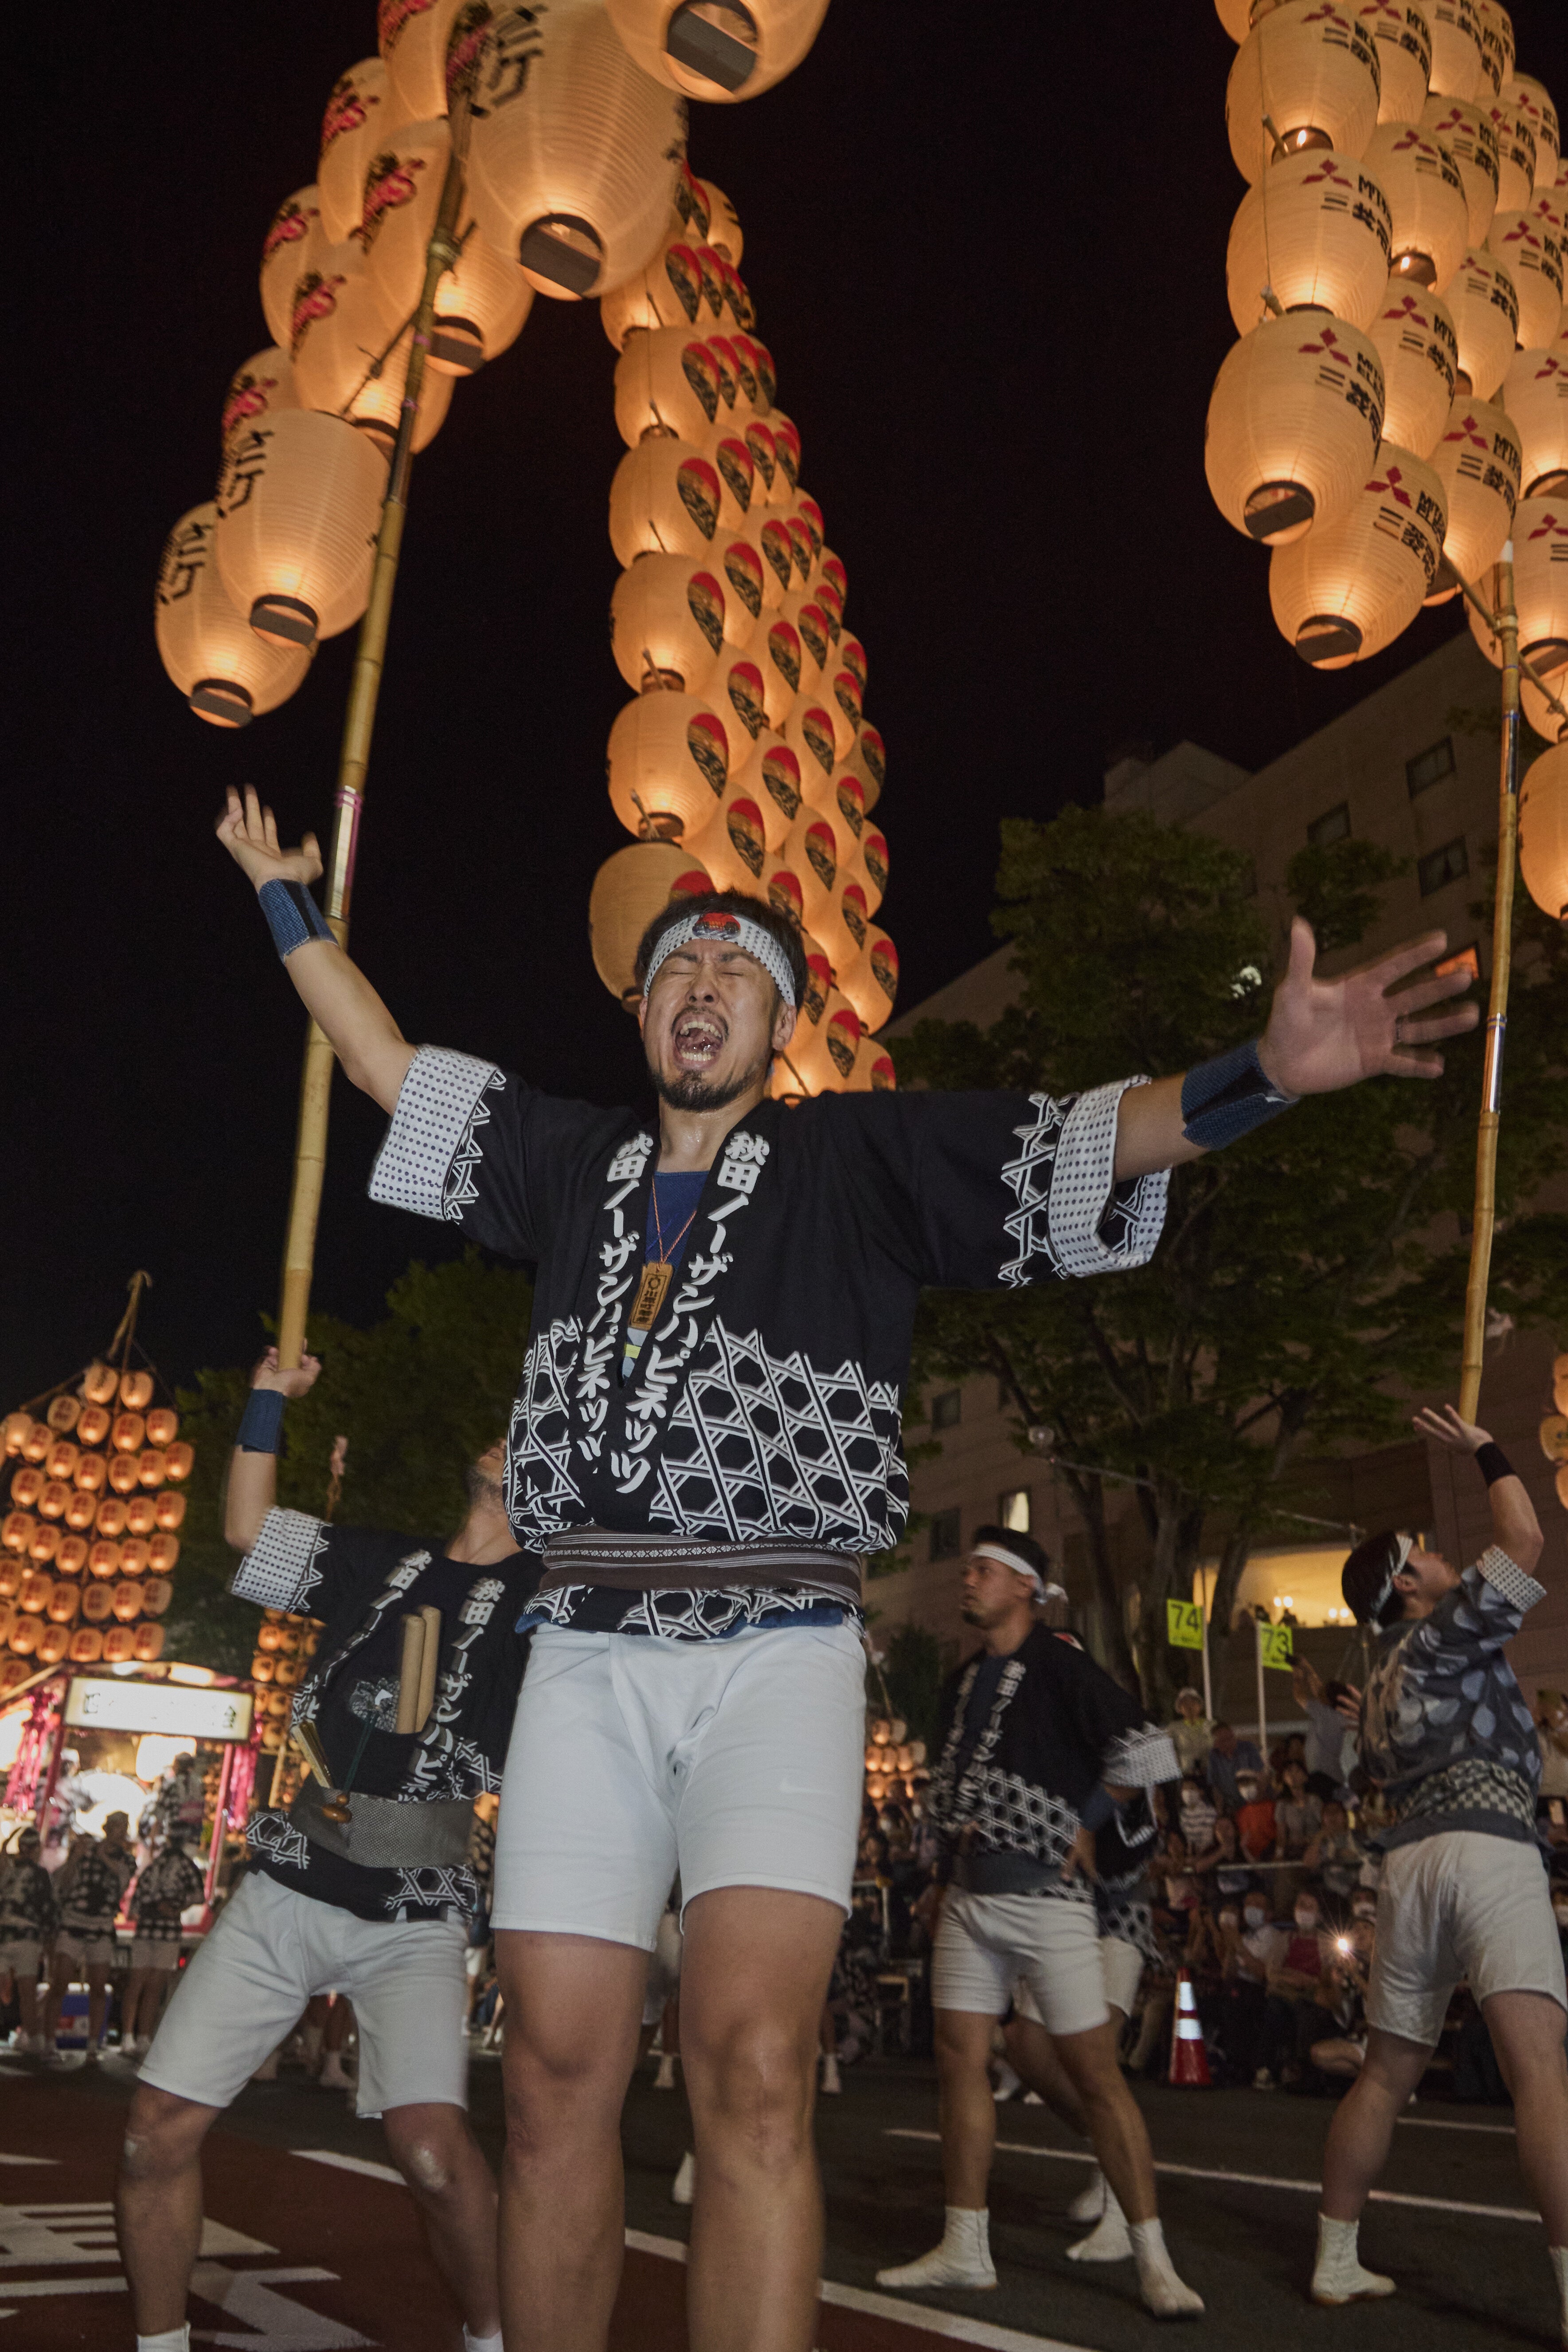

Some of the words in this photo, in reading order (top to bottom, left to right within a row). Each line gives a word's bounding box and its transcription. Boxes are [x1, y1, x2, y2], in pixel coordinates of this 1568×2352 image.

[615, 1131, 770, 1494] 秋田ノーザンハピネッツ
[1171, 1604, 1199, 1632] 74
